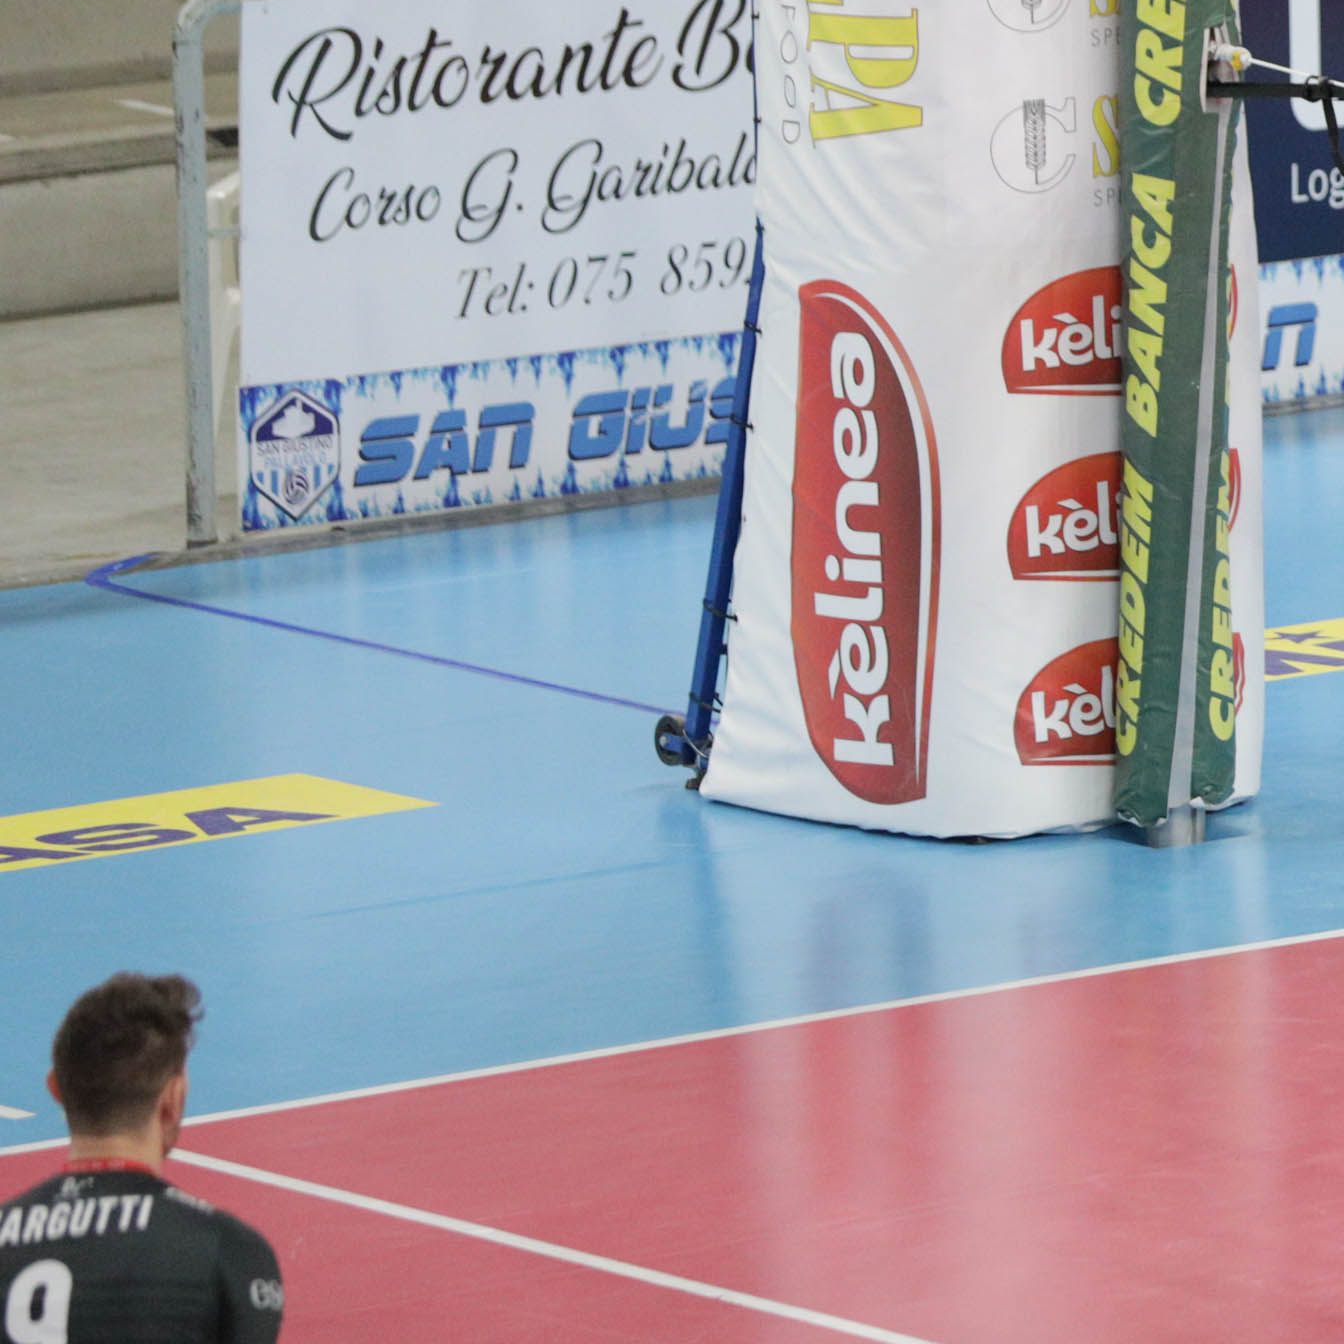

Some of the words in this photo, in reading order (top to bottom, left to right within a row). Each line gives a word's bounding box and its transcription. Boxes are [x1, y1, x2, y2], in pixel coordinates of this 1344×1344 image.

[271, 7, 659, 141] Ristorante
[780, 3, 800, 146] FOOD
[309, 167, 439, 242] Corso
[455, 147, 525, 243] G.
[455, 262, 527, 320] Tel:
[548, 250, 636, 309] 075
[658, 235, 751, 295] 859
[1127, 172, 1176, 438] BANCA
[1114, 453, 1155, 756] CREDEM
[0, 1194, 153, 1247] ARGUTTI
[5, 1258, 73, 1344] 9
